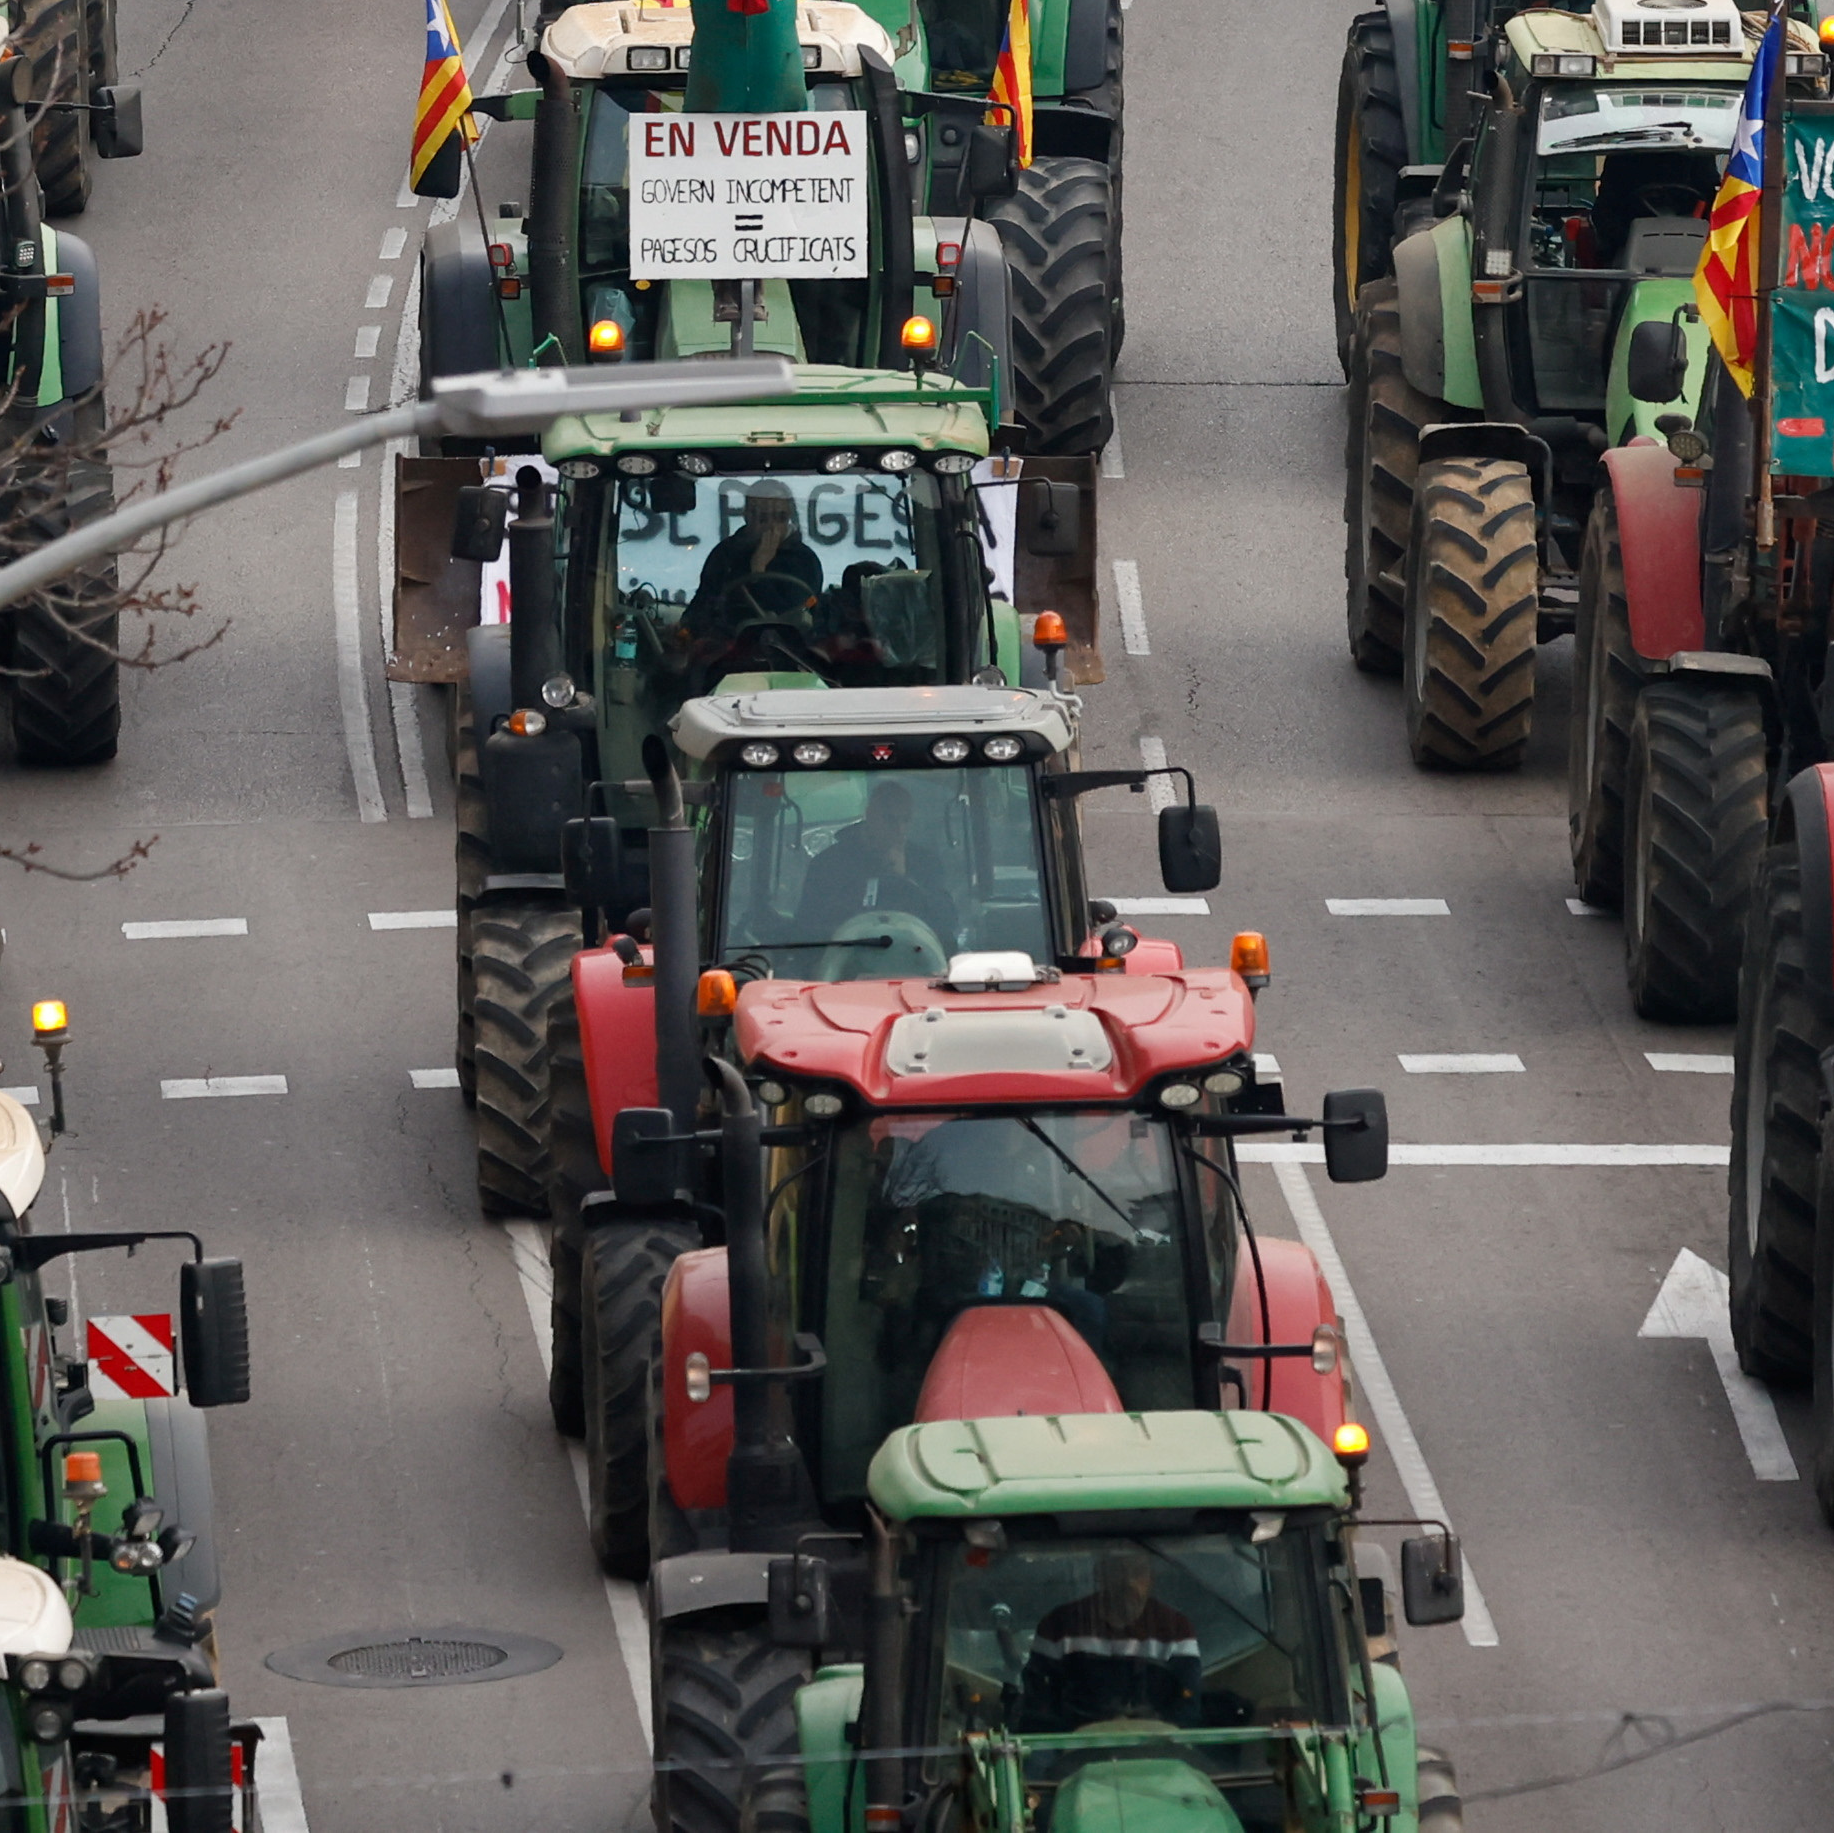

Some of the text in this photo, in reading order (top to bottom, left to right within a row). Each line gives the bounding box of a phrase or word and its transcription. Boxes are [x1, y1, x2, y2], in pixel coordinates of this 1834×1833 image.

[644, 119, 852, 157] EN VENDA
[640, 177, 856, 204] GOVERN INCOMPETENT
[640, 236, 857, 264] PAGESOS CRUCIFICATS
